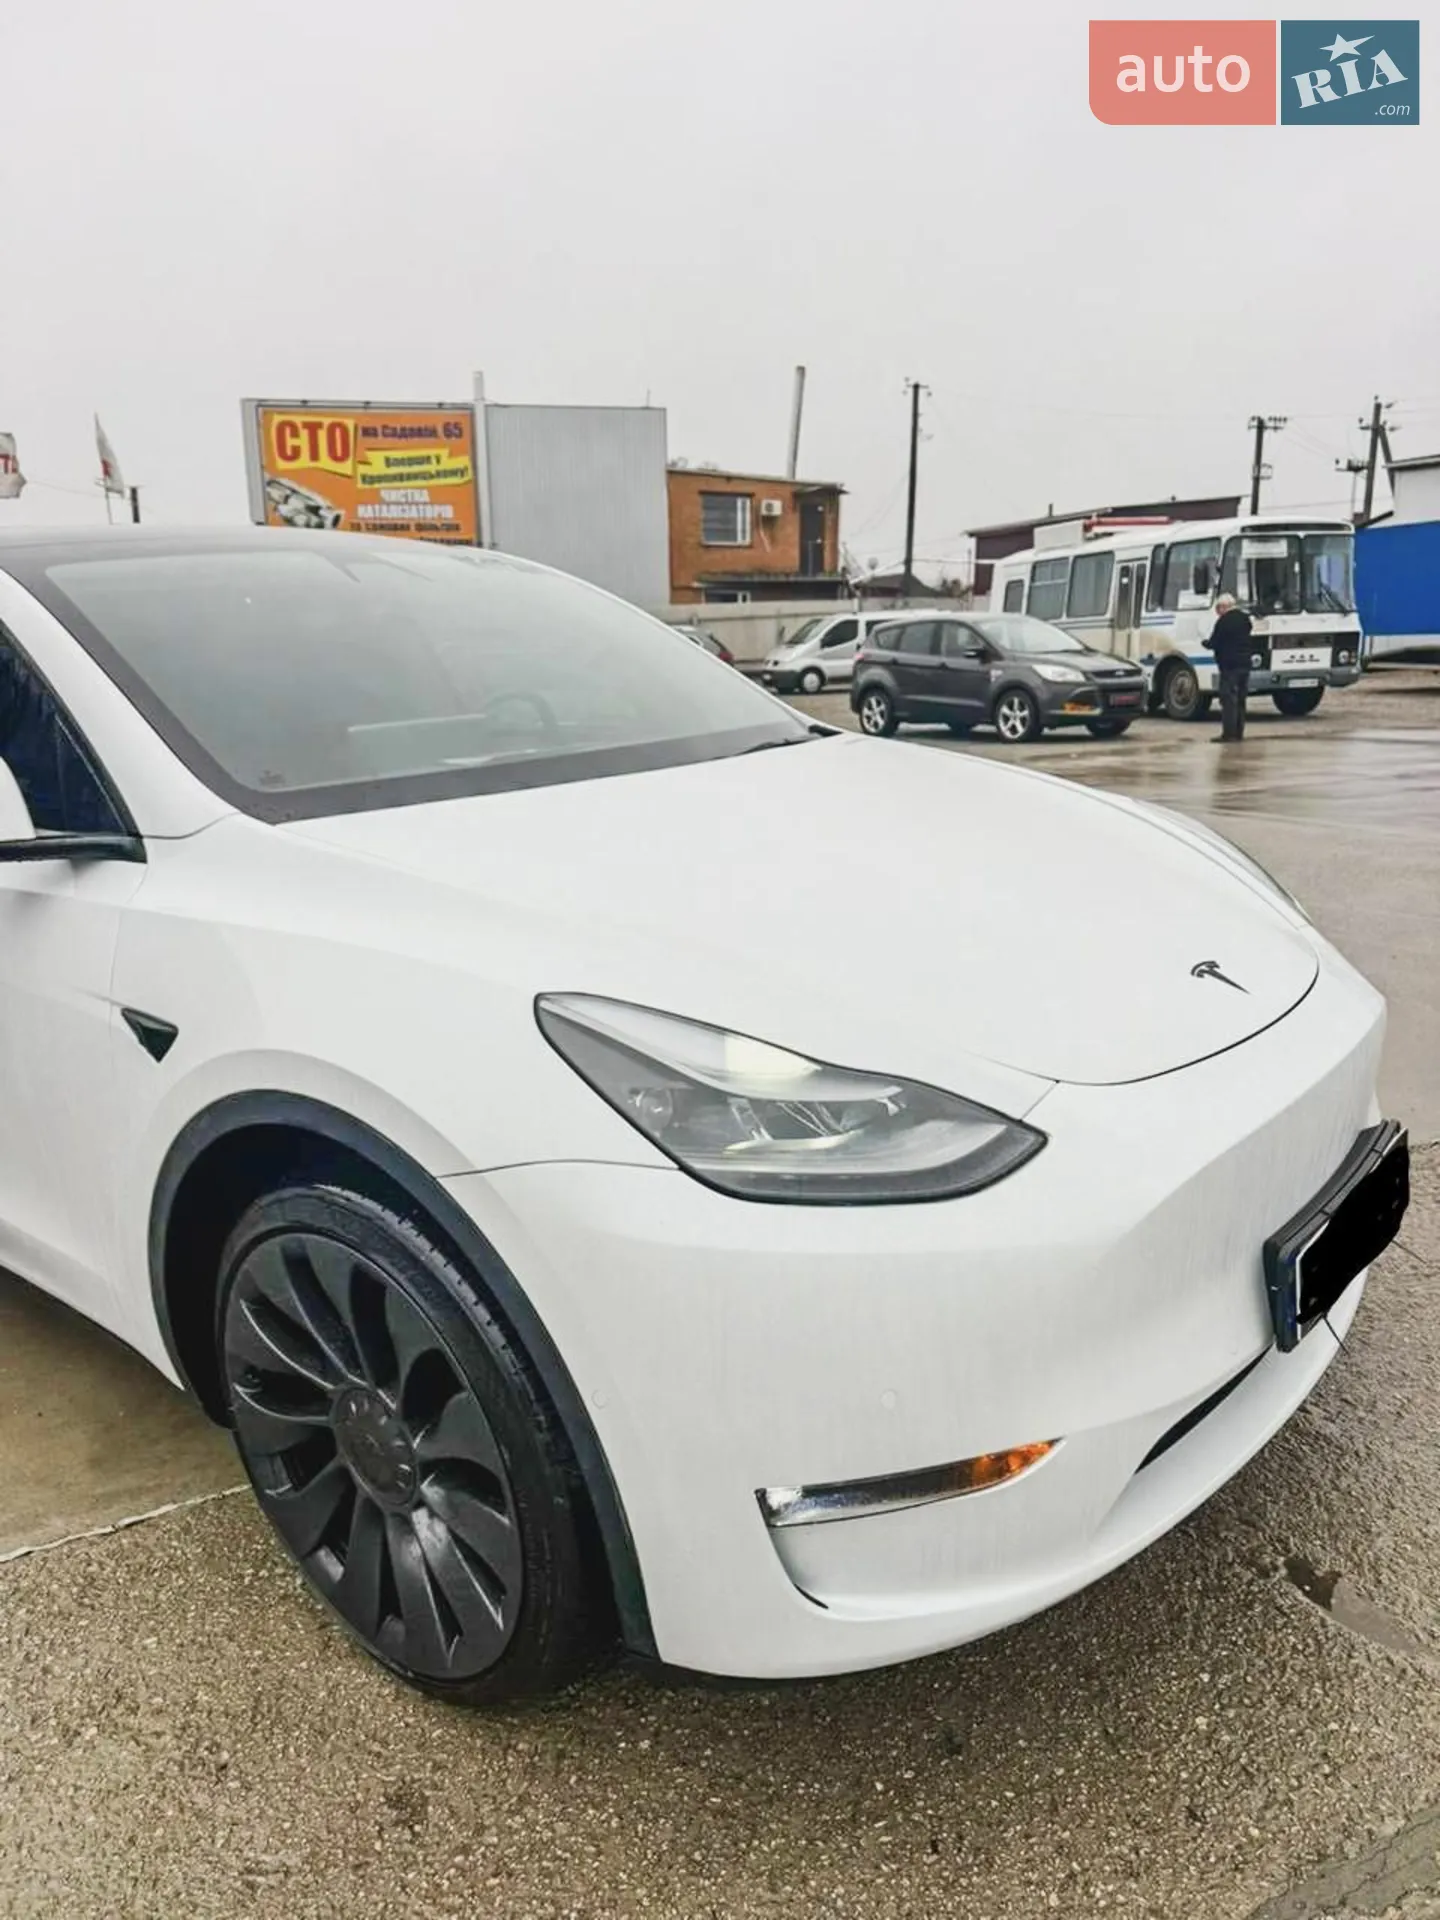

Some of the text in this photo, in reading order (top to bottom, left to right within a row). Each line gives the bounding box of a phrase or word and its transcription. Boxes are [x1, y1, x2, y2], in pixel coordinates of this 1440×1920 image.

[275, 420, 350, 463] СТО
[361, 426, 378, 437] на
[442, 422, 462, 438] 65
